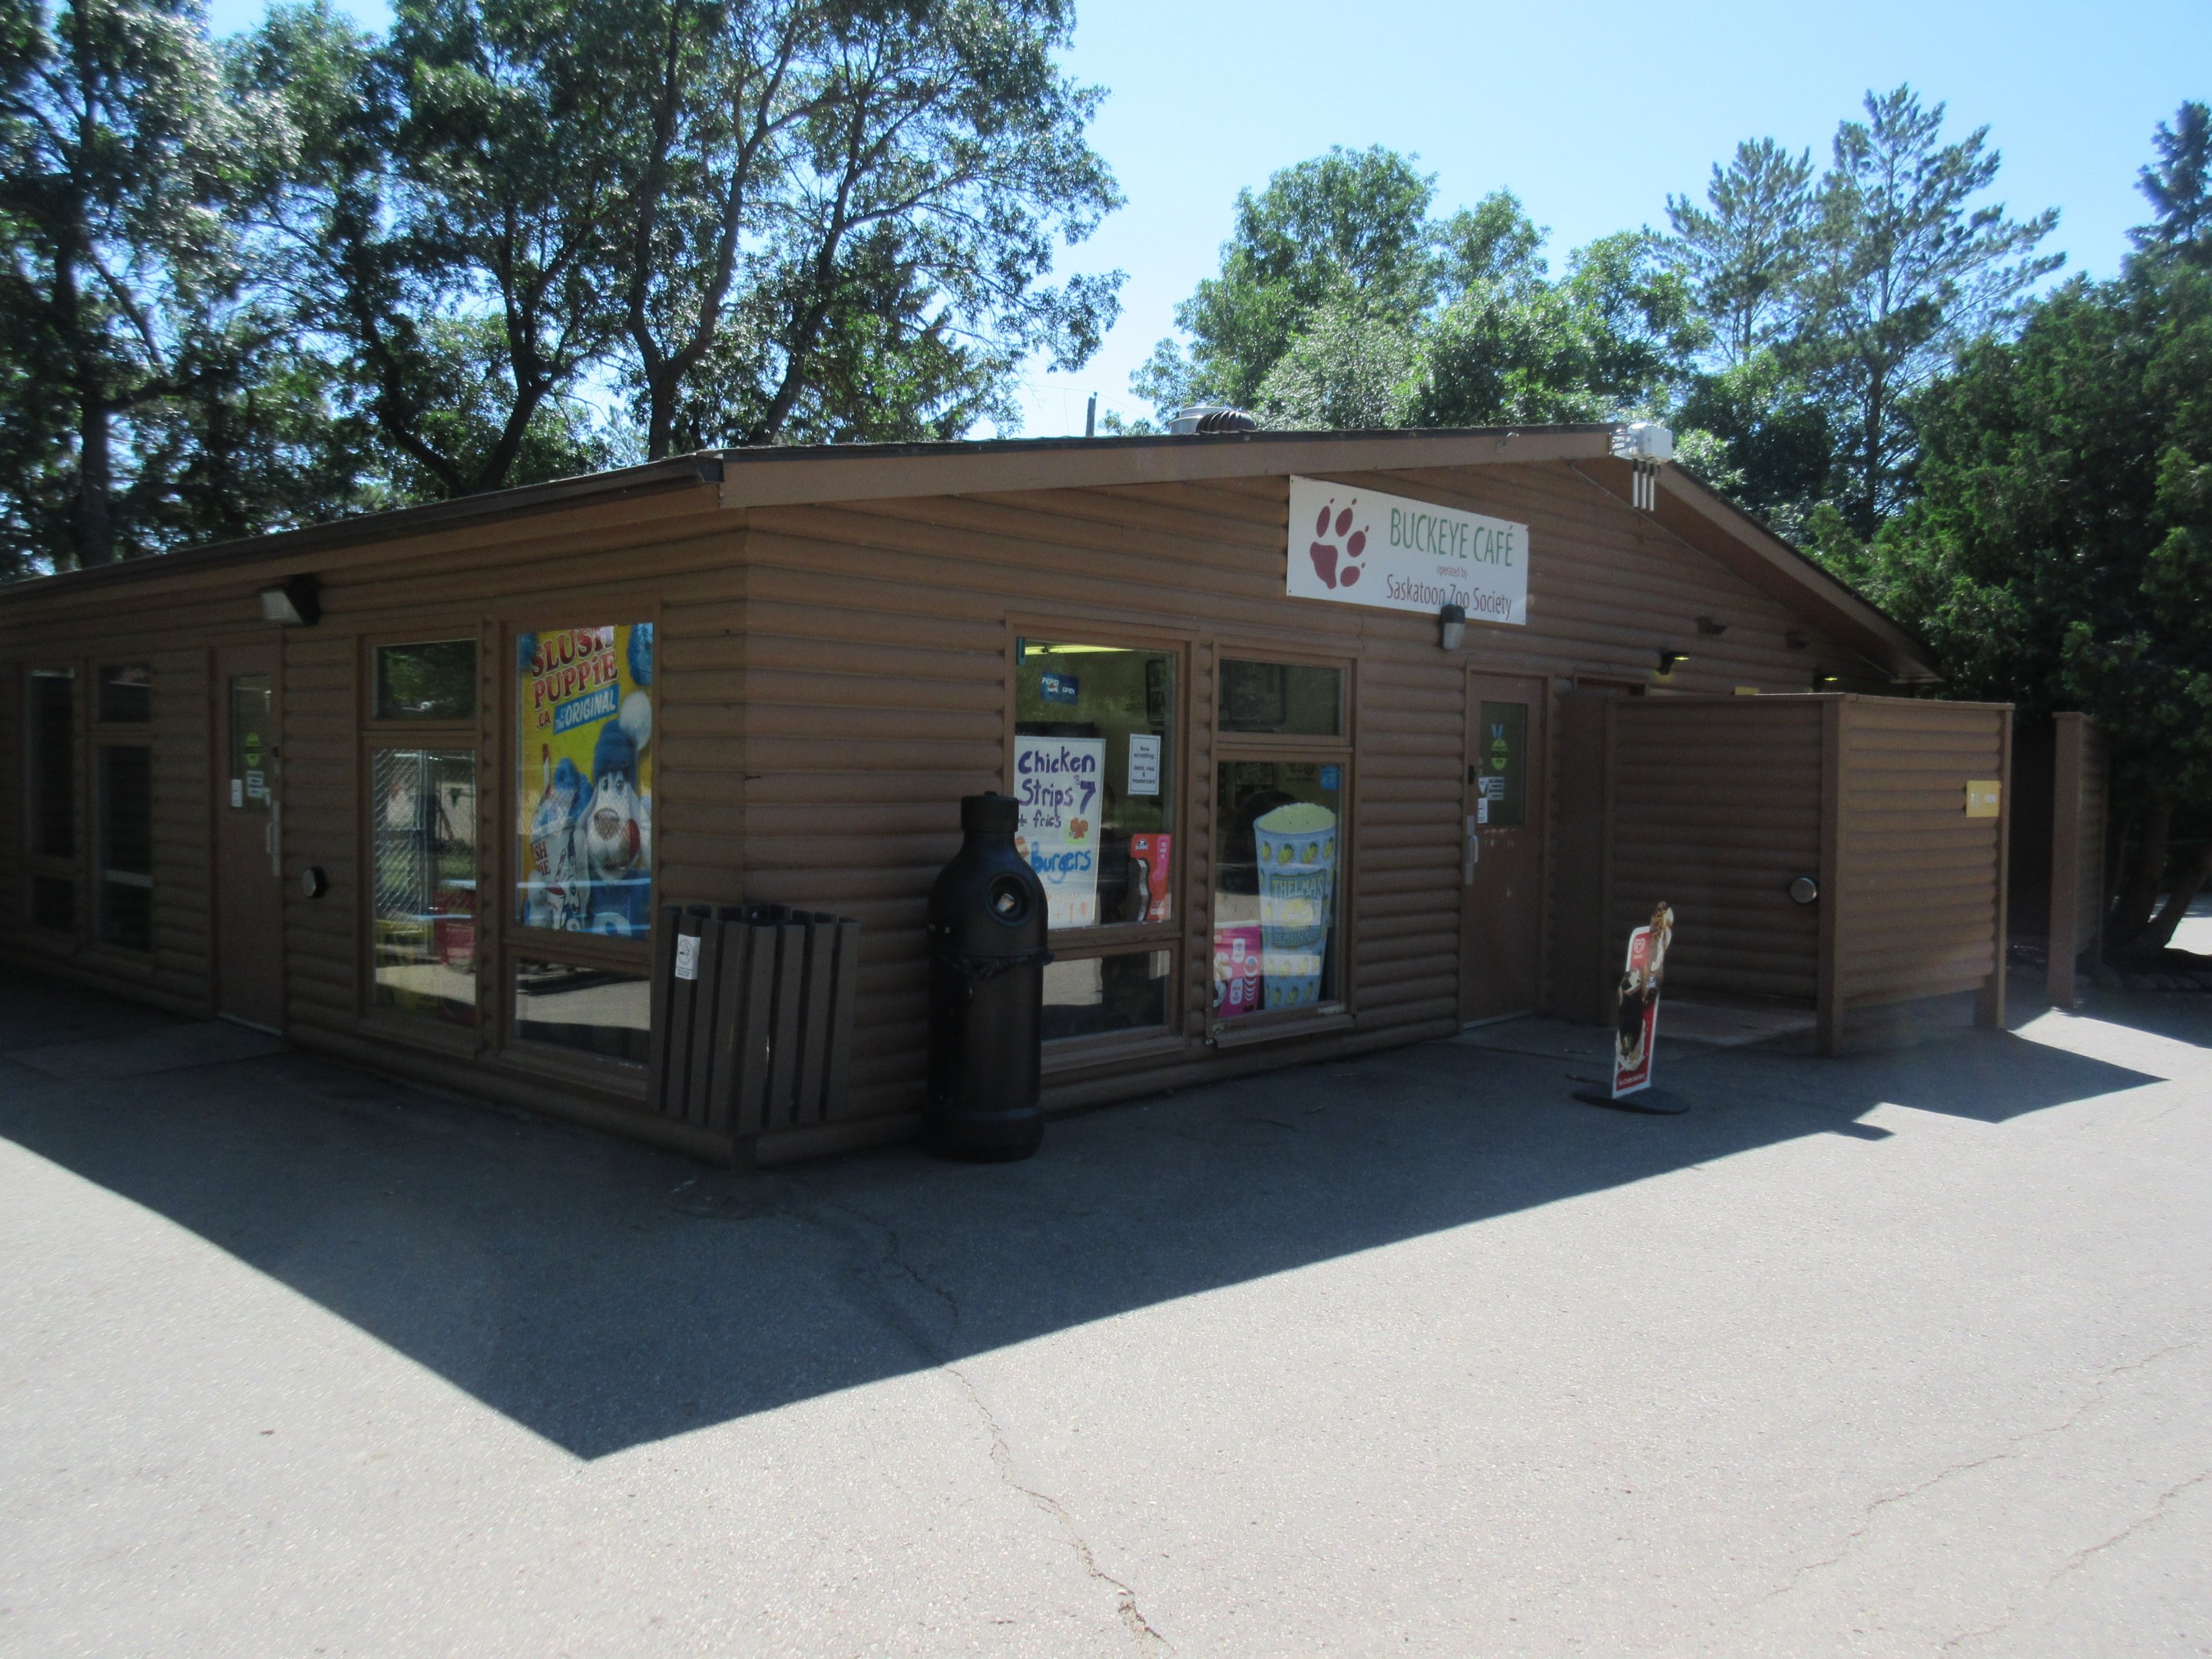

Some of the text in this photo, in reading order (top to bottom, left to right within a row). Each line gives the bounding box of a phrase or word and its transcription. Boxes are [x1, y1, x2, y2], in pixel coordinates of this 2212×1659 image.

[1390, 508, 1513, 566] BUCKEYE CAFÉ
[1436, 565, 1468, 581] operated by
[1386, 574, 1512, 621] Saskatoon Zoo Society
[531, 627, 614, 677] SLUSH
[1041, 677, 1059, 687] PEPSI
[565, 689, 616, 727] ORIGINAL
[1018, 745, 1096, 774] Chicken
[1019, 778, 1074, 817] Strips
[1032, 810, 1061, 828] fries
[1031, 841, 1091, 884] burgers
